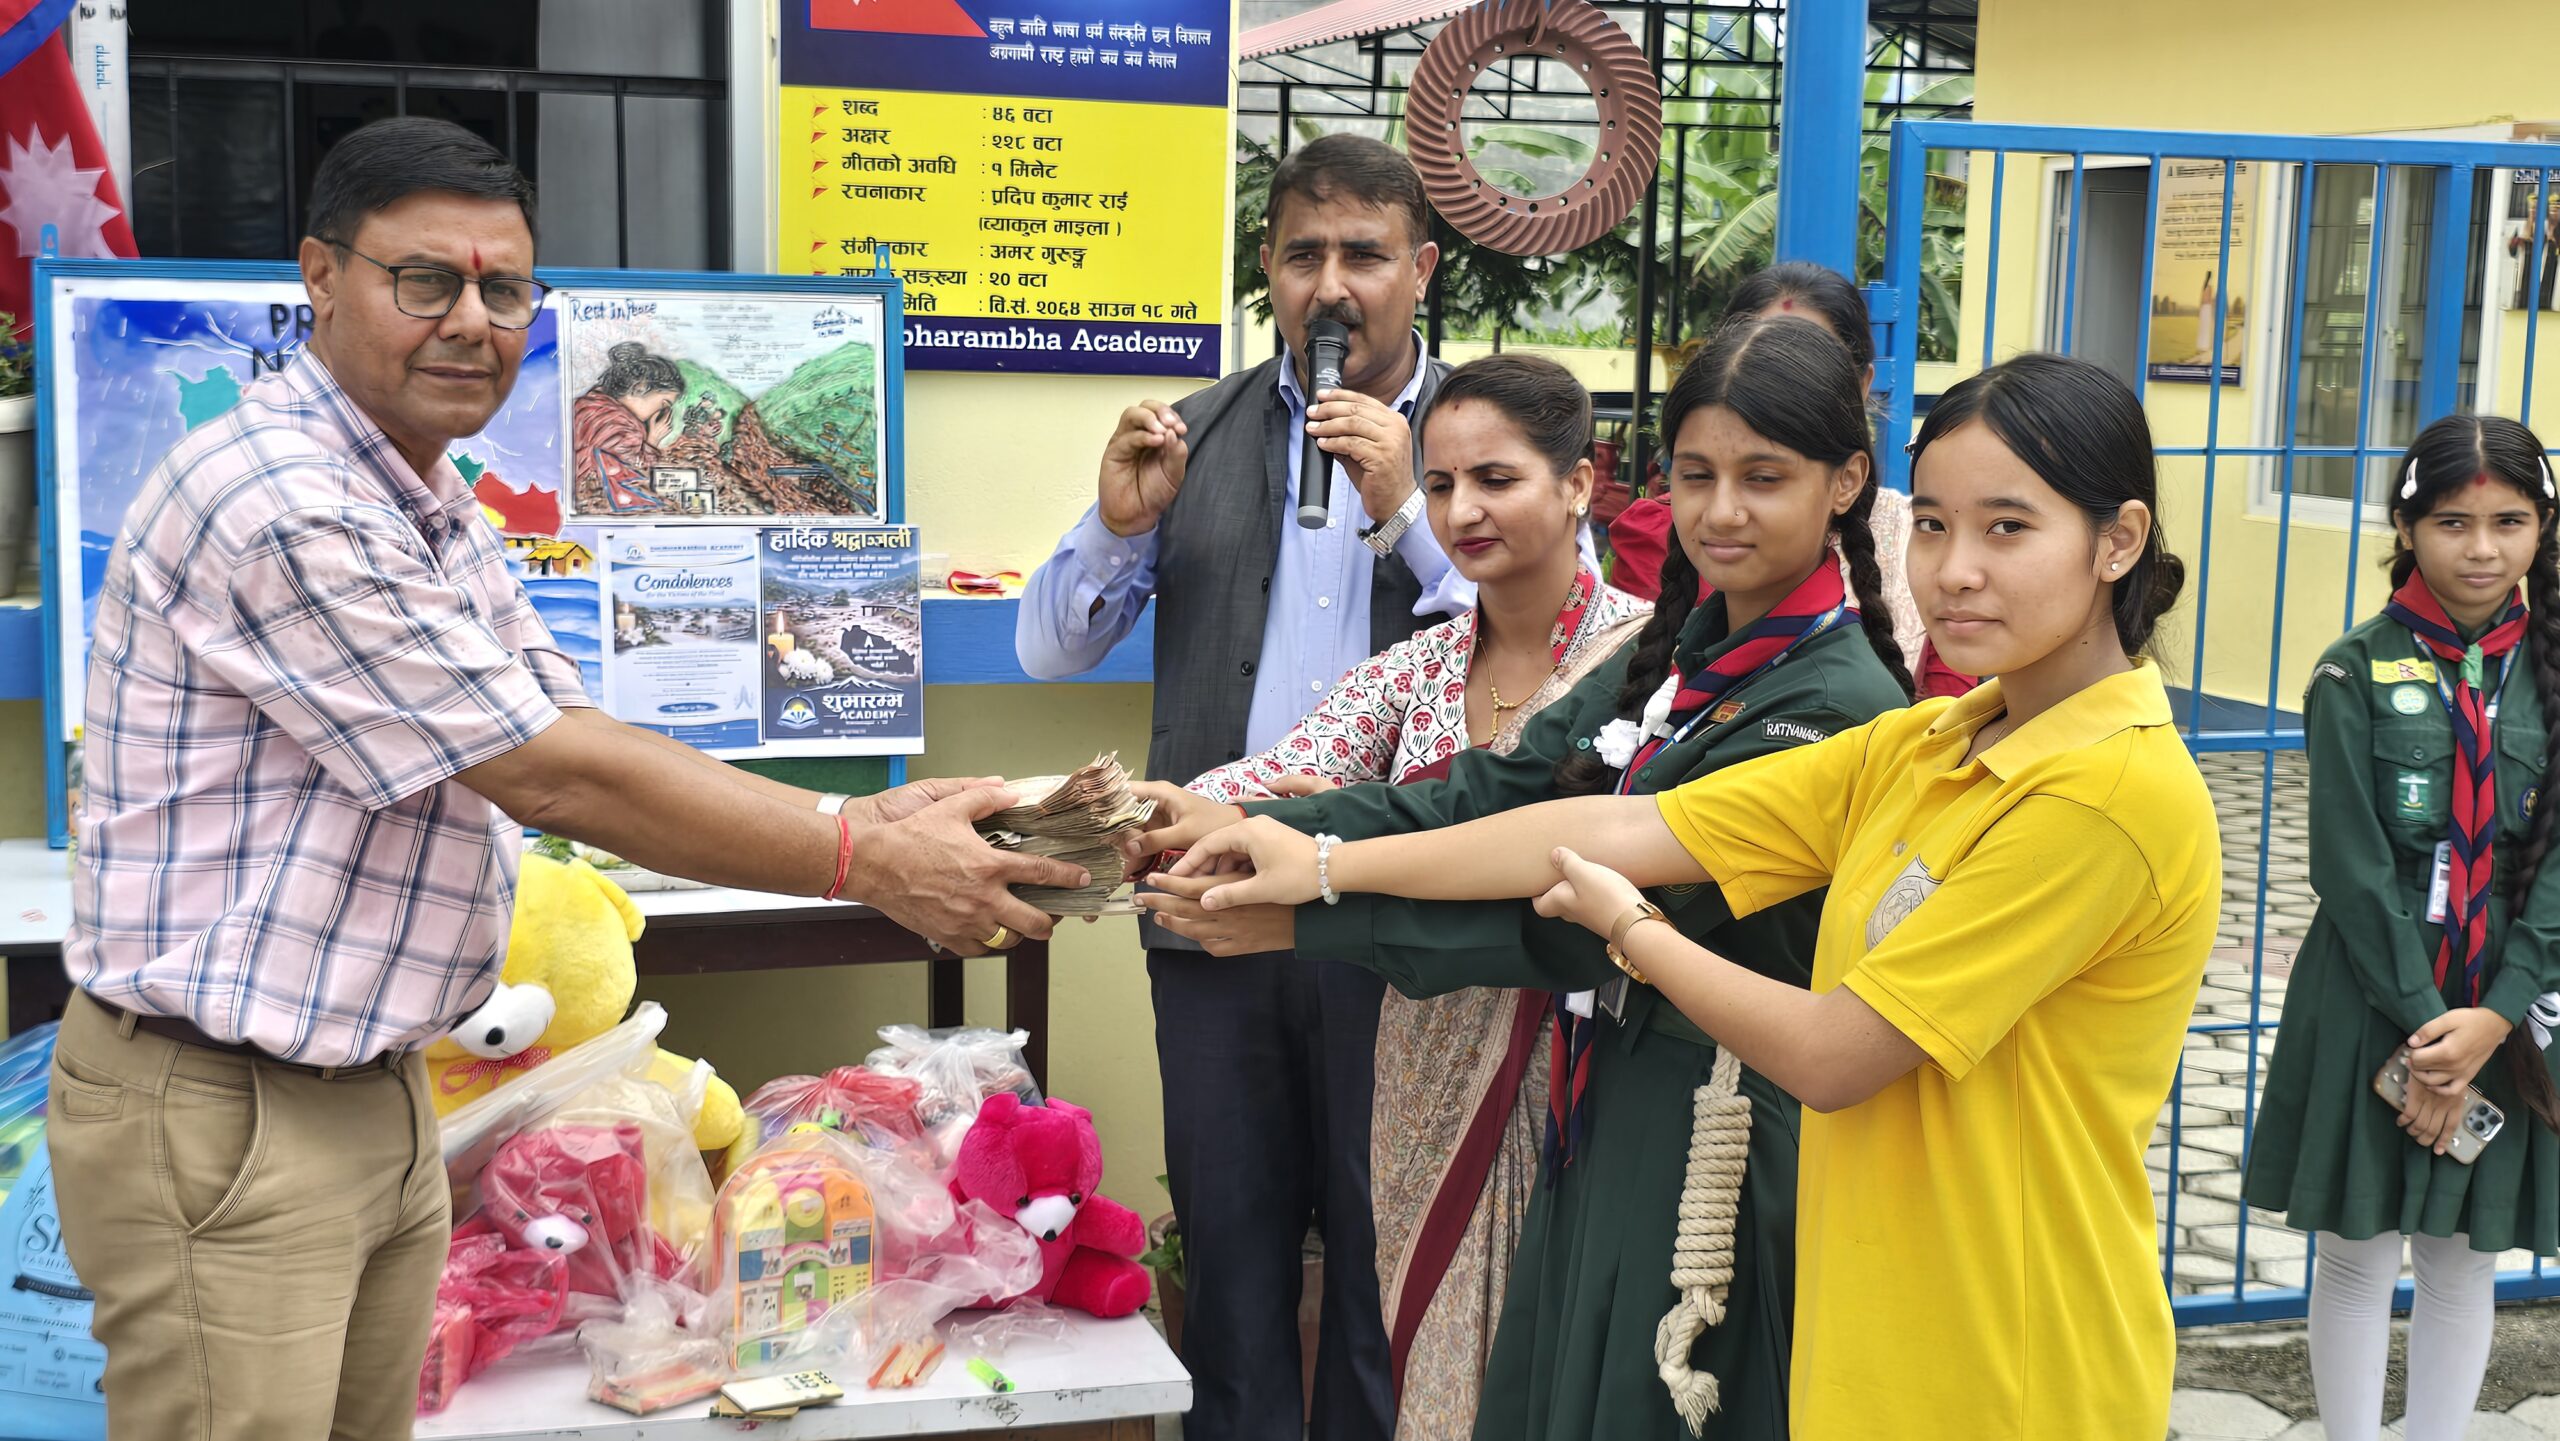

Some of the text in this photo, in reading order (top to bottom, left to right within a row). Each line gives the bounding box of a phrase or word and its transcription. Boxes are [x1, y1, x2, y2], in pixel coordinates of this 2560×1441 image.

[989, 17, 1014, 40] बहुल
[1019, 14, 1047, 37] जाति
[1052, 20, 1080, 39] भाषा
[1085, 18, 1104, 40] धर्म
[1108, 17, 1147, 47] संस्कृति
[1175, 22, 1212, 46] विशाल
[989, 41, 1035, 62] अग्रगामी
[1099, 49, 1119, 66] जय
[1123, 50, 1143, 67] जय
[1148, 47, 1178, 69] नेपाल
[842, 99, 880, 116] शब्द
[992, 106, 1015, 123] ४६
[1023, 108, 1053, 124] वटा
[842, 127, 892, 145] अक्षर
[991, 135, 1026, 151] २२८
[1033, 136, 1063, 152] वटा
[842, 152, 902, 173] गीतको
[908, 156, 957, 175] अवधि
[991, 162, 1002, 177] १
[1010, 158, 1058, 179] मिनेट
[841, 183, 927, 203] रचनाकार
[991, 186, 1036, 206] प्रदिप
[1042, 191, 1094, 211] कुमार
[1099, 191, 1129, 212] राई
[978, 216, 1048, 237] (व्याकुल
[1053, 219, 1110, 237] माइला
[990, 245, 1036, 261] अमर
[989, 272, 1011, 287] २०
[1018, 272, 1048, 288] वटा
[1036, 300, 1081, 317] २०६४
[1087, 301, 1136, 318] साउन
[1141, 303, 1164, 319] १८
[1170, 300, 1198, 320] गते
[1070, 327, 1204, 360] Academy
[769, 527, 829, 552] हार्दिक
[633, 573, 734, 592] Condolences
[839, 710, 897, 721] ACADEMY
[1766, 722, 1829, 743] RATNANAGA
